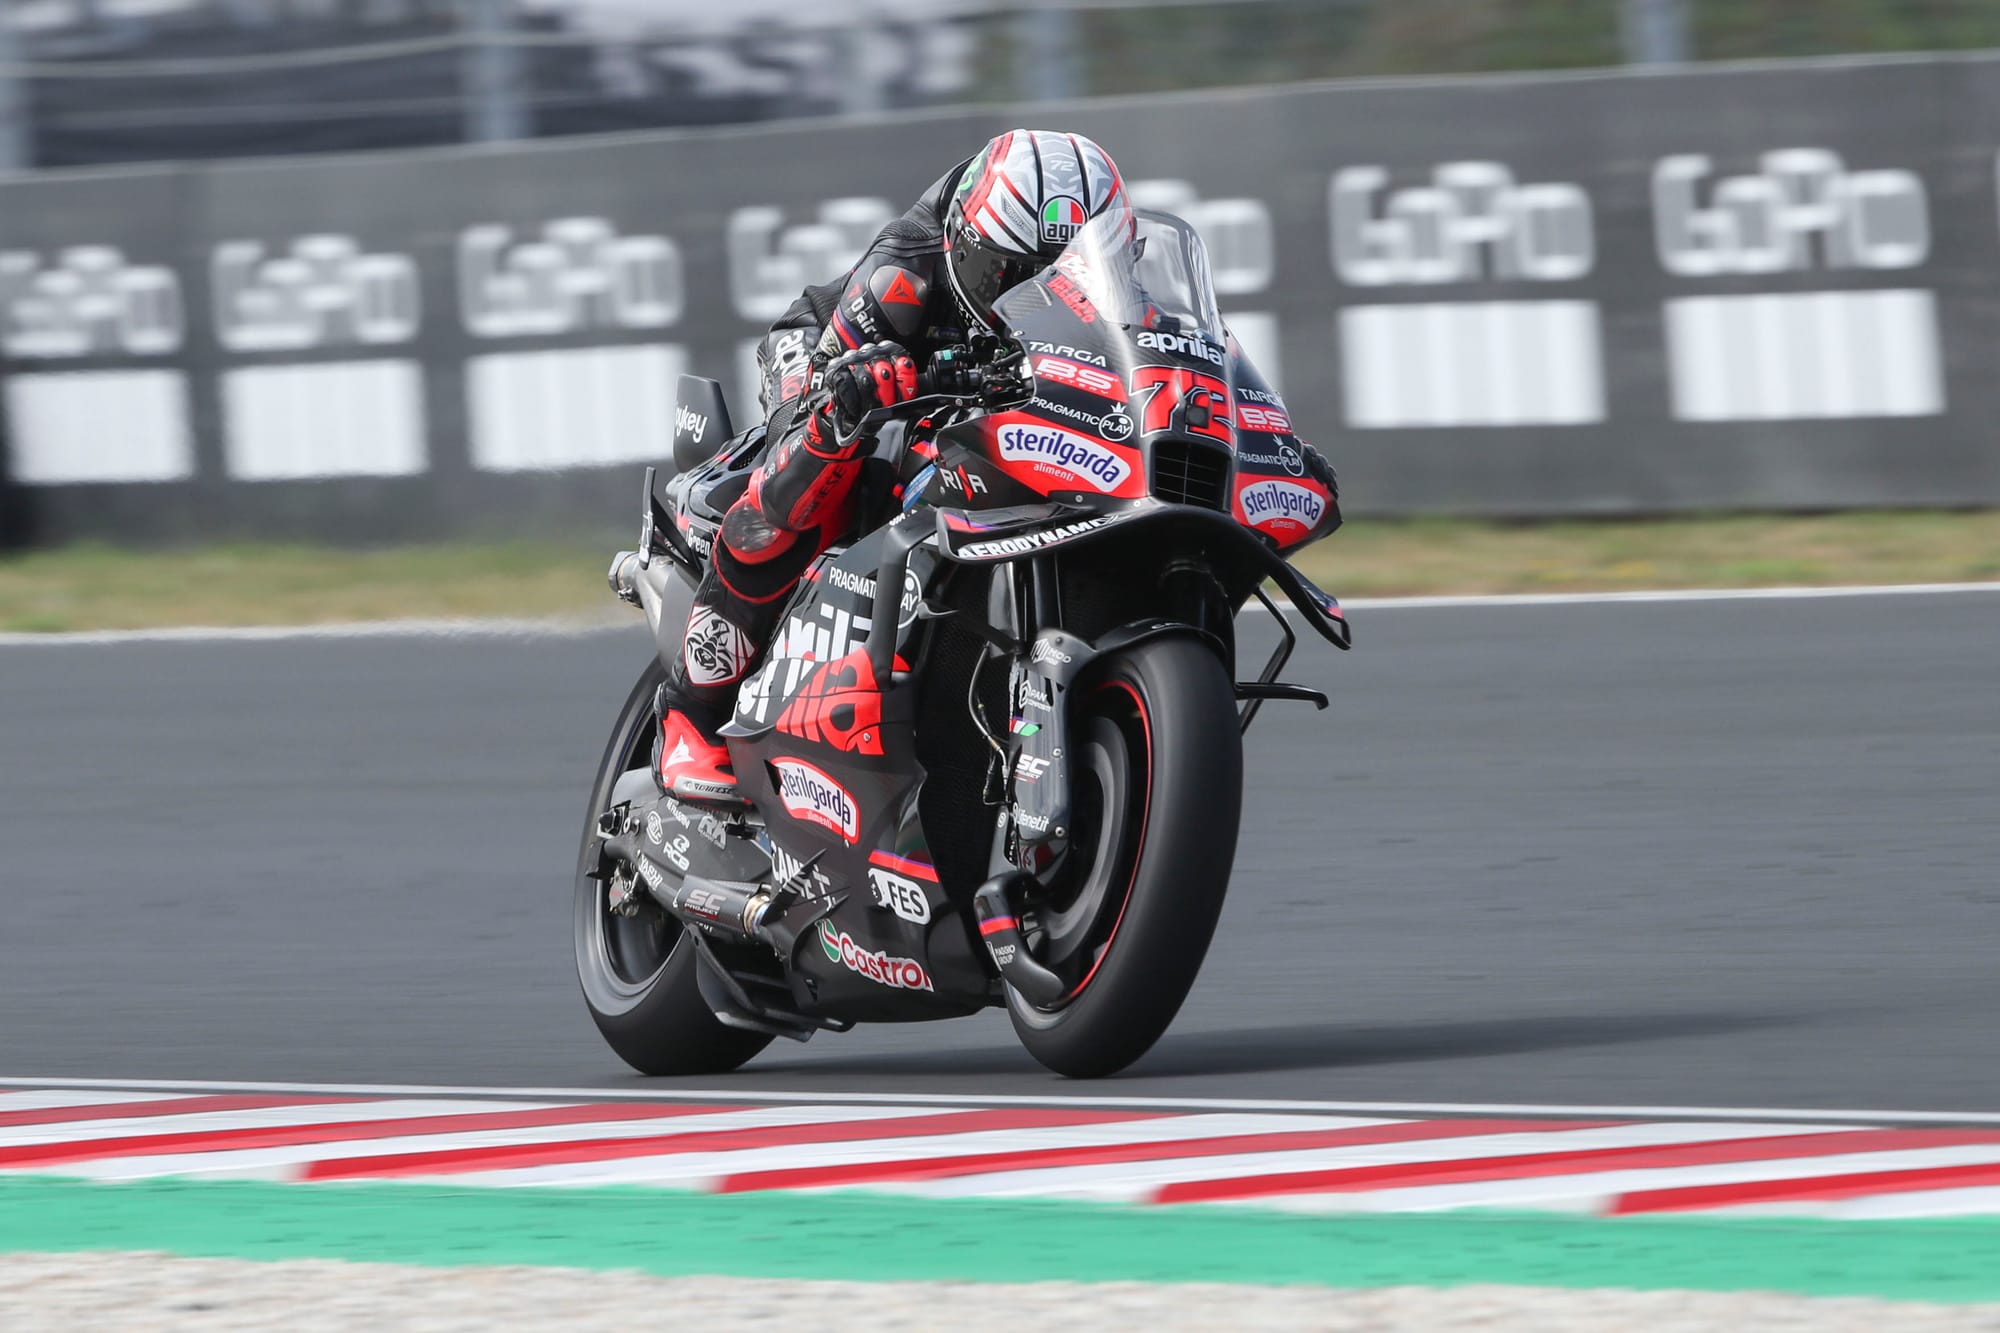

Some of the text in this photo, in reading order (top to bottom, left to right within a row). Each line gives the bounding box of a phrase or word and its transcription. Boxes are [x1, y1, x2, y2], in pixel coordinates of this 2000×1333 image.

[1029, 341, 1107, 368] TARGA
[1136, 331, 1224, 367] aprilia
[1036, 358, 1114, 390] BS
[1030, 396, 1132, 435] PRAGMATIC PLAY
[1128, 364, 1238, 452] 72
[1239, 407, 1290, 428] BS
[1004, 428, 1121, 484] sterilgarda
[1033, 462, 1076, 482] alimenti
[1238, 451, 1282, 466] PRAGMATIC
[1245, 483, 1320, 520] sterilgarda
[829, 566, 876, 598] PRAGMATI
[900, 592, 918, 612] AY
[1016, 753, 1051, 776] SC
[686, 888, 727, 911] SC
[884, 880, 926, 917] FES
